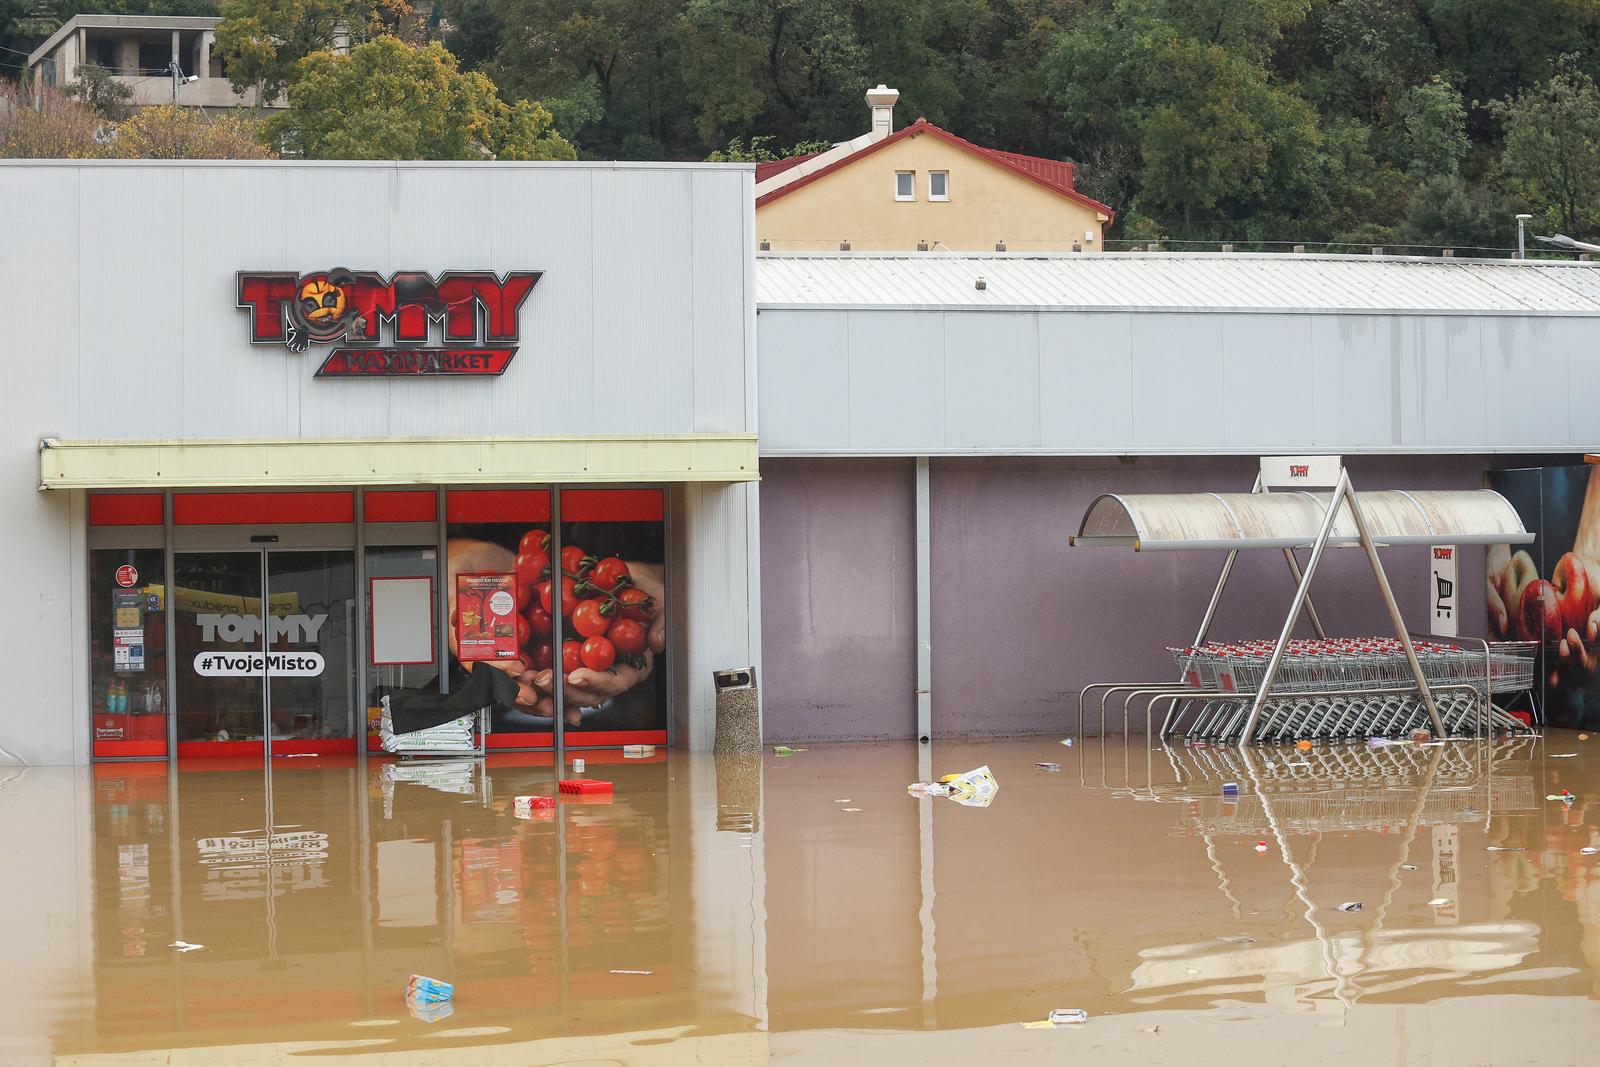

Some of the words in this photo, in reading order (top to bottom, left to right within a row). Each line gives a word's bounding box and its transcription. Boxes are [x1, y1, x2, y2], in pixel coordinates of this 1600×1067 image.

[236, 267, 545, 344] TOMMY
[345, 353, 493, 369] MAXIMARKET
[1290, 465, 1309, 477] TOMMY
[1433, 547, 1452, 560] TOMMY
[196, 613, 329, 643] TOMMY
[202, 655, 317, 673] #TvojeMisto
